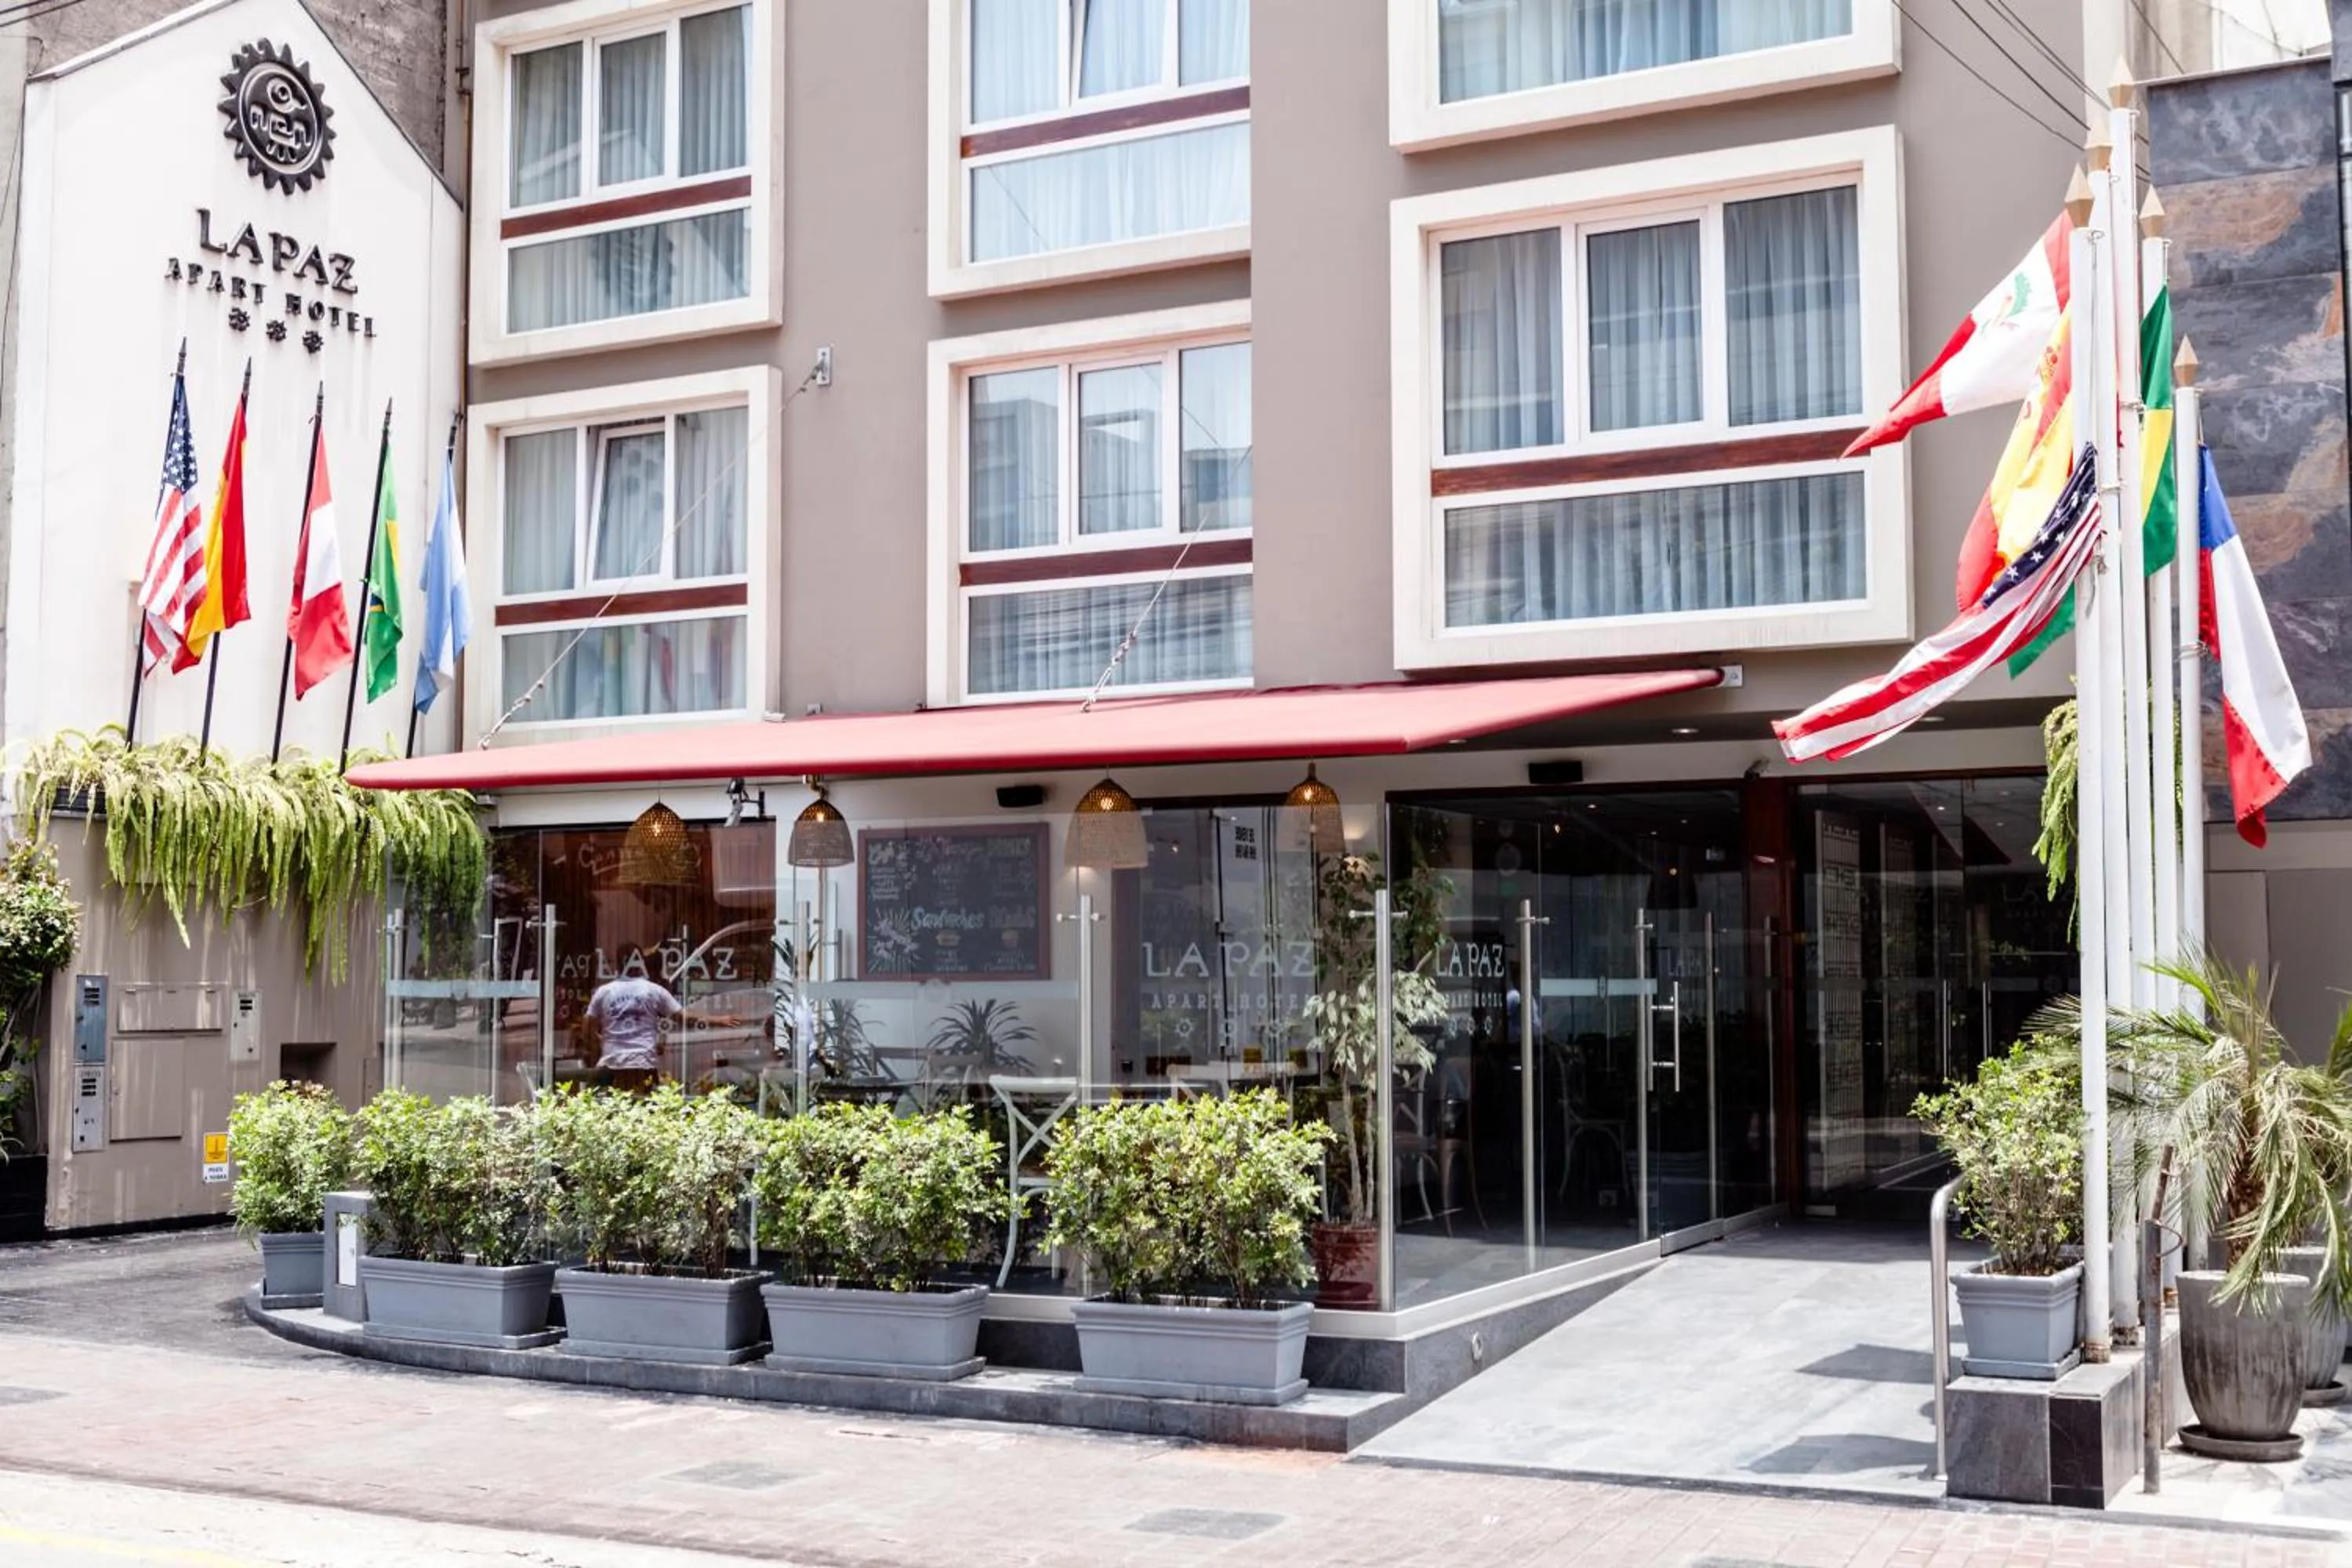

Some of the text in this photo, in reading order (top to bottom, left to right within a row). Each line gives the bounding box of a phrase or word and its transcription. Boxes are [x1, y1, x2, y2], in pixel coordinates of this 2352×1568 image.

[163, 256, 377, 338] APART HOTEL
[595, 946, 739, 981] LA PAZ
[1141, 940, 1319, 979] LA PAZ
[1434, 942, 1505, 978] LA PAZ
